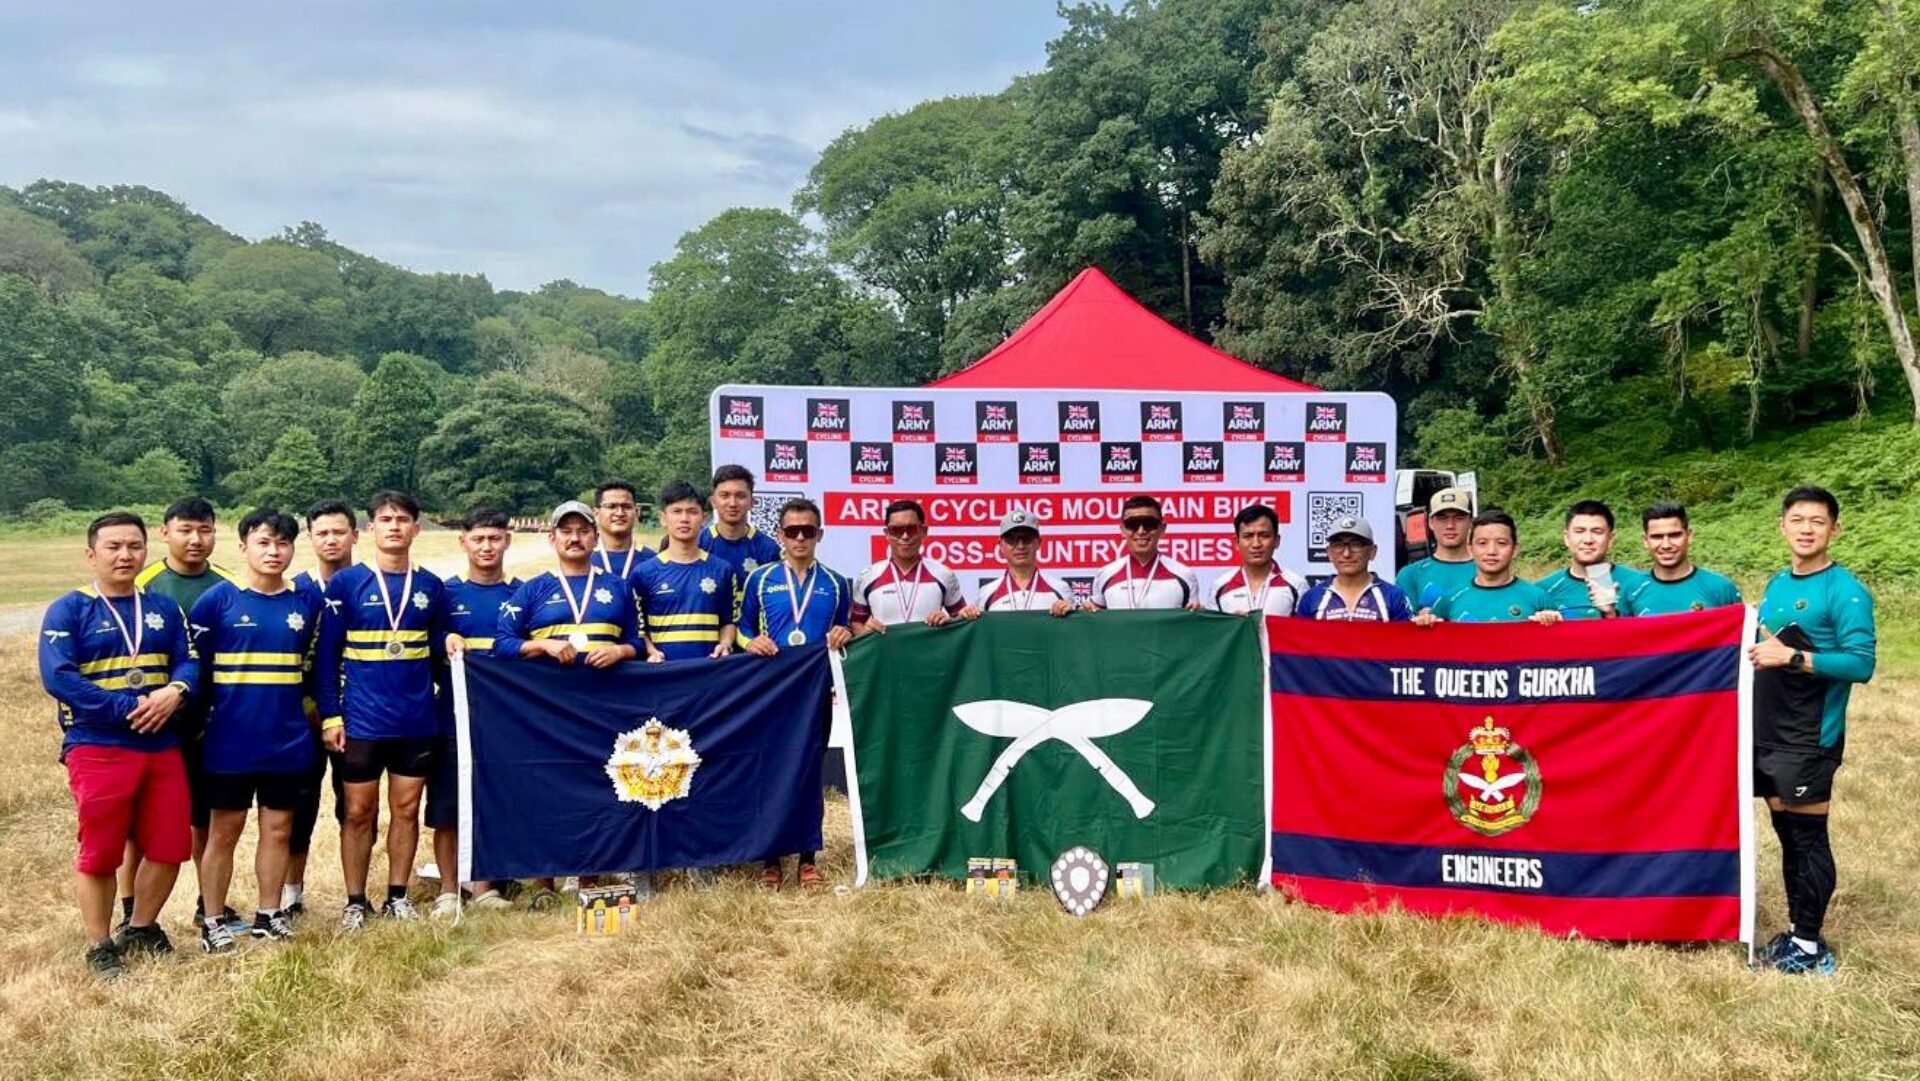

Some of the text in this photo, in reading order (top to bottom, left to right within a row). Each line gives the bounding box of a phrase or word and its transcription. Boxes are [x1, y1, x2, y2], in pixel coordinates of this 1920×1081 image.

[724, 414, 760, 426] ARMY
[812, 417, 846, 429] ARMY
[897, 419, 930, 430] ARMY
[981, 419, 1013, 430] ARMY
[1063, 419, 1096, 430] ARMY
[1145, 418, 1178, 430] ARMY
[1228, 419, 1261, 430] ARMY
[1310, 419, 1342, 430] ARMY
[769, 458, 804, 470] ARMY
[855, 460, 889, 472] ARMY
[940, 461, 973, 472] ARMY
[1023, 461, 1056, 472] ARMY
[1105, 460, 1138, 471] ARMY
[1187, 459, 1220, 470] ARMY
[1268, 459, 1301, 470] ARMY
[1350, 460, 1382, 471] ARMY
[930, 498, 1054, 520] CYCLING
[1062, 496, 1204, 520] MOUAIN
[1157, 538, 1233, 562] ERIES
[1390, 667, 1425, 695] THE
[1518, 666, 1596, 697] GURKHA
[1441, 854, 1543, 888] ENGINEERS
